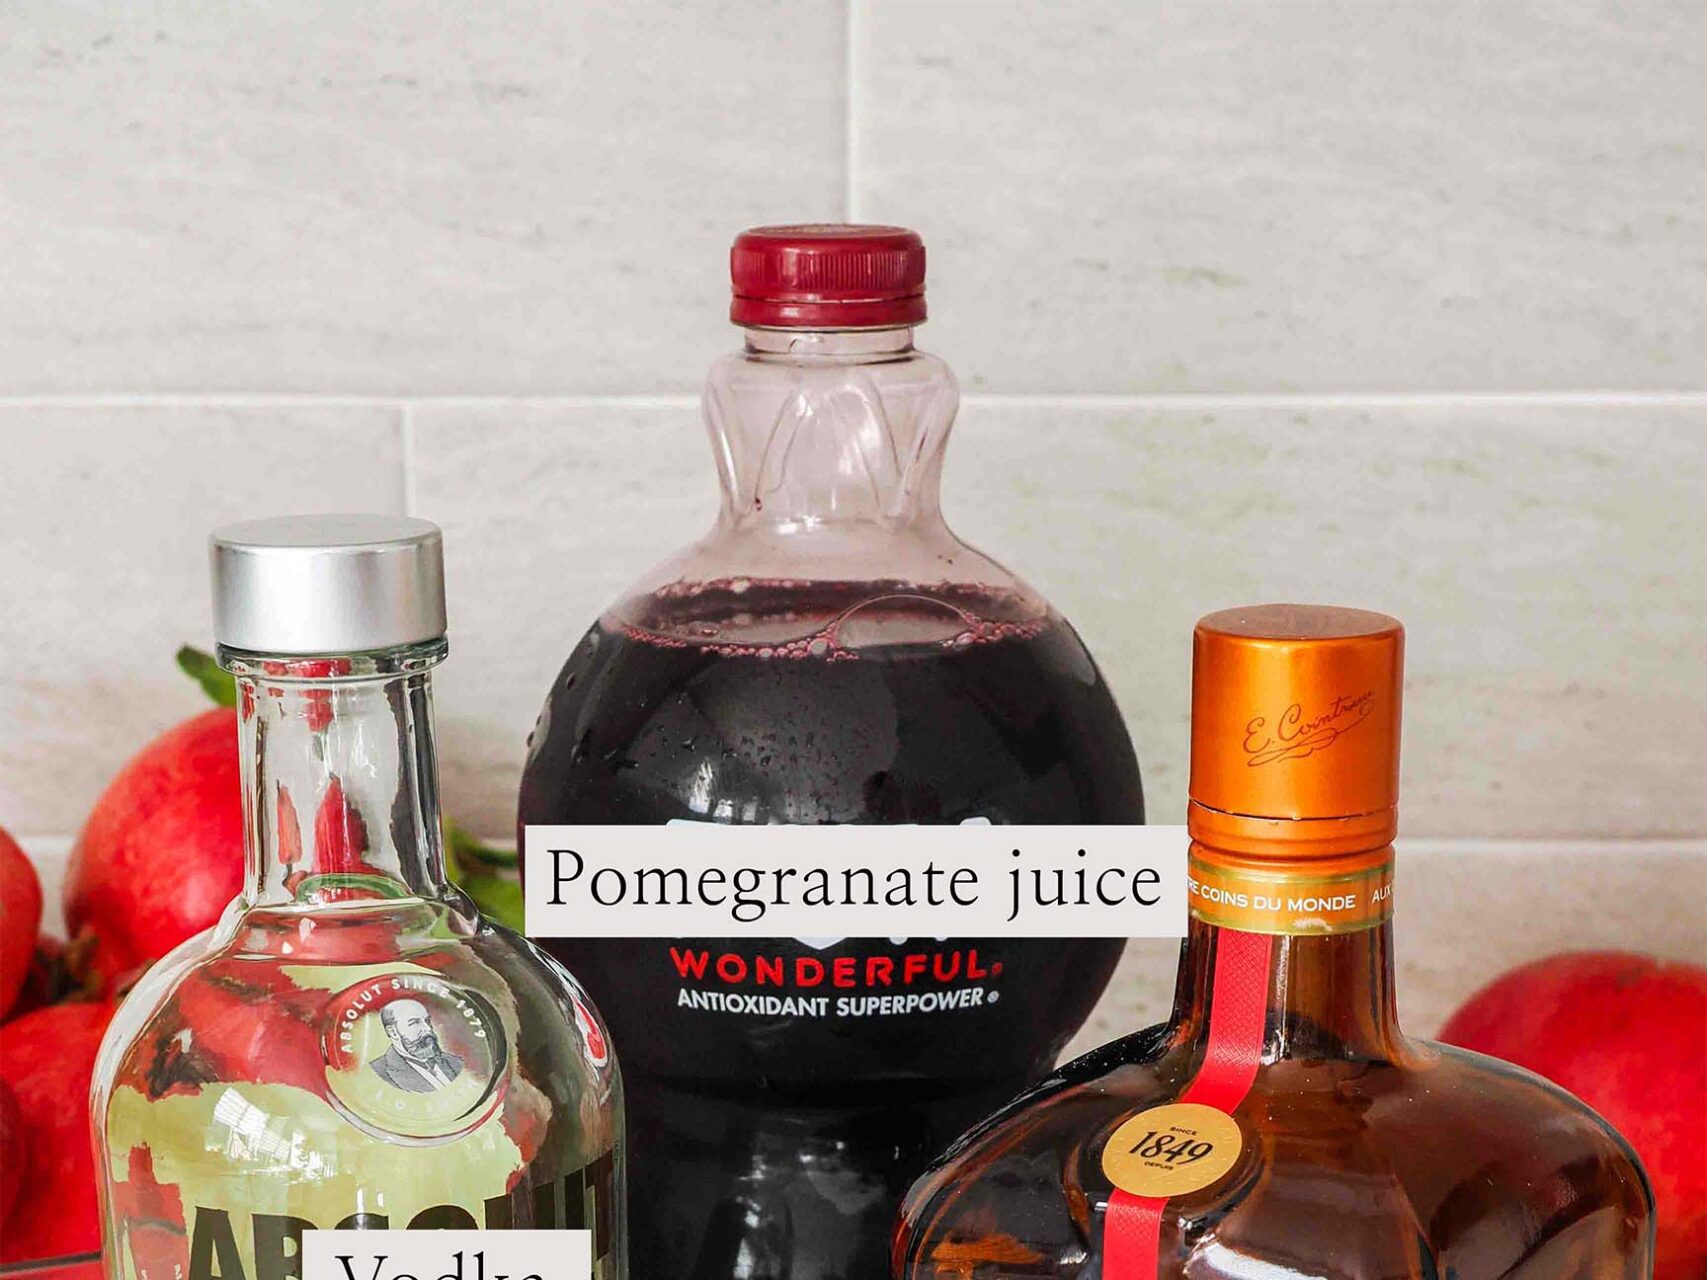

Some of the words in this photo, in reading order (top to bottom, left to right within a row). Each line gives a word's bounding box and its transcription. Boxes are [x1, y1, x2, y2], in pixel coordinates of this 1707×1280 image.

[1201, 884, 1249, 909] COINS
[1253, 895, 1282, 911] DU
[1287, 894, 1357, 912] MONDE
[340, 984, 382, 1054] ABSOLUT
[391, 977, 450, 999] SINCE
[456, 999, 487, 1039] 1879
[677, 987, 829, 1016] ANTIOXIDANT
[1169, 1126, 1198, 1136] SINCE
[1128, 1131, 1214, 1165] 1849
